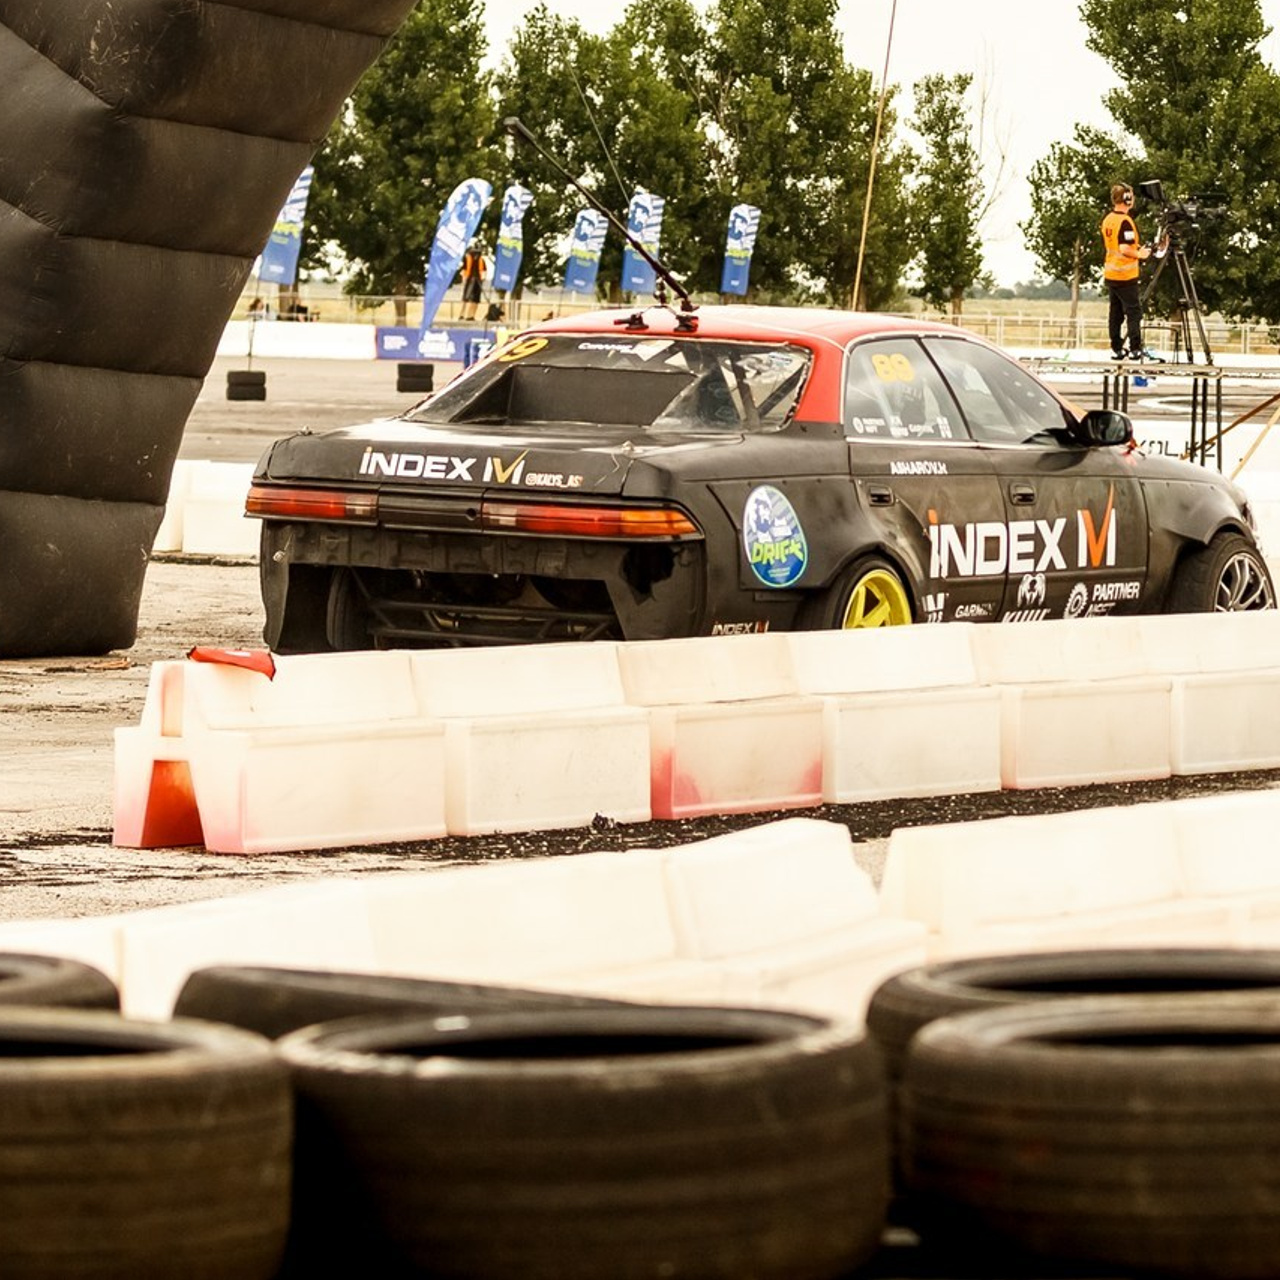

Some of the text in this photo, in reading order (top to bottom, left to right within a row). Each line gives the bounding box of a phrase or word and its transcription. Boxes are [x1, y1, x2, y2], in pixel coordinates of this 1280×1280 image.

[359, 447, 477, 481] INDEX
[928, 509, 1067, 580] INDEX
[1092, 582, 1141, 602] PARTNER
[711, 621, 752, 635] INDEX
